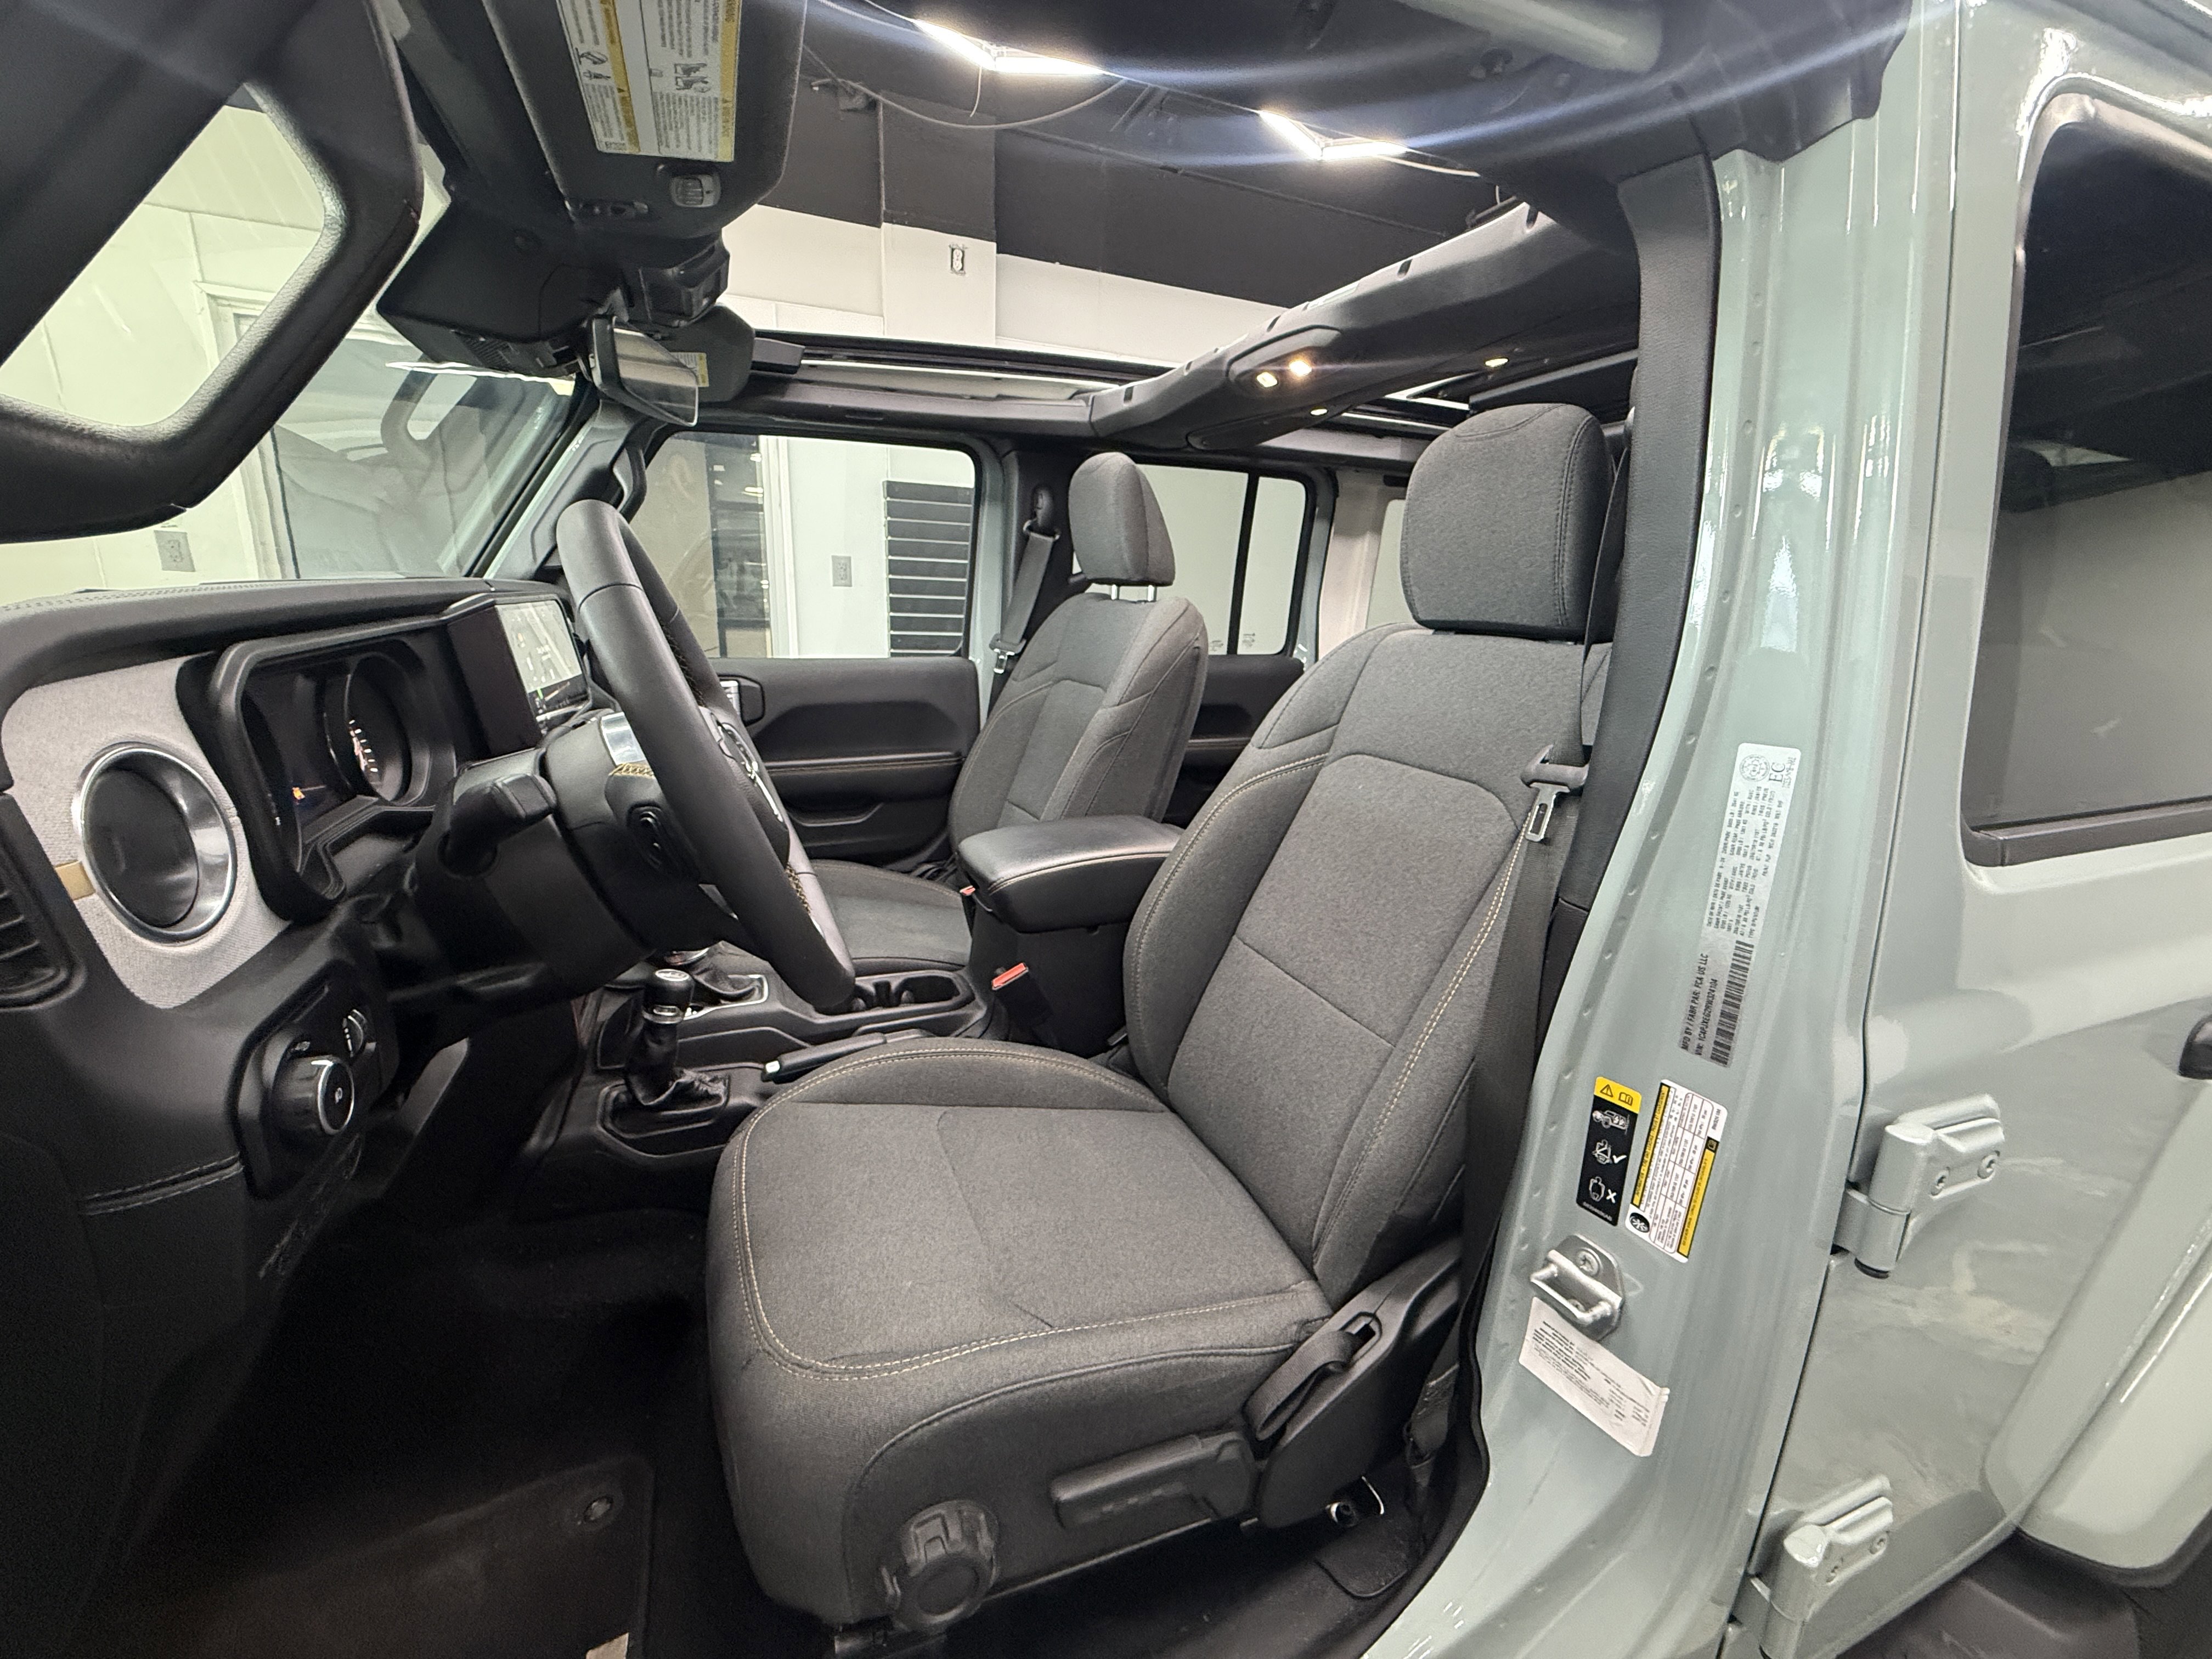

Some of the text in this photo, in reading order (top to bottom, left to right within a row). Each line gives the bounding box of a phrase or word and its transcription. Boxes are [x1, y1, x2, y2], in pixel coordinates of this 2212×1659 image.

[1768, 762, 1786, 782] EC
[1699, 953, 1708, 965] LLC
[1697, 966, 1705, 975] US
[1694, 976, 1703, 989] FCA
[1688, 1005, 1697, 1022] FABR
[1684, 1026, 1692, 1035] BY
[1681, 1036, 1690, 1050] MFD
